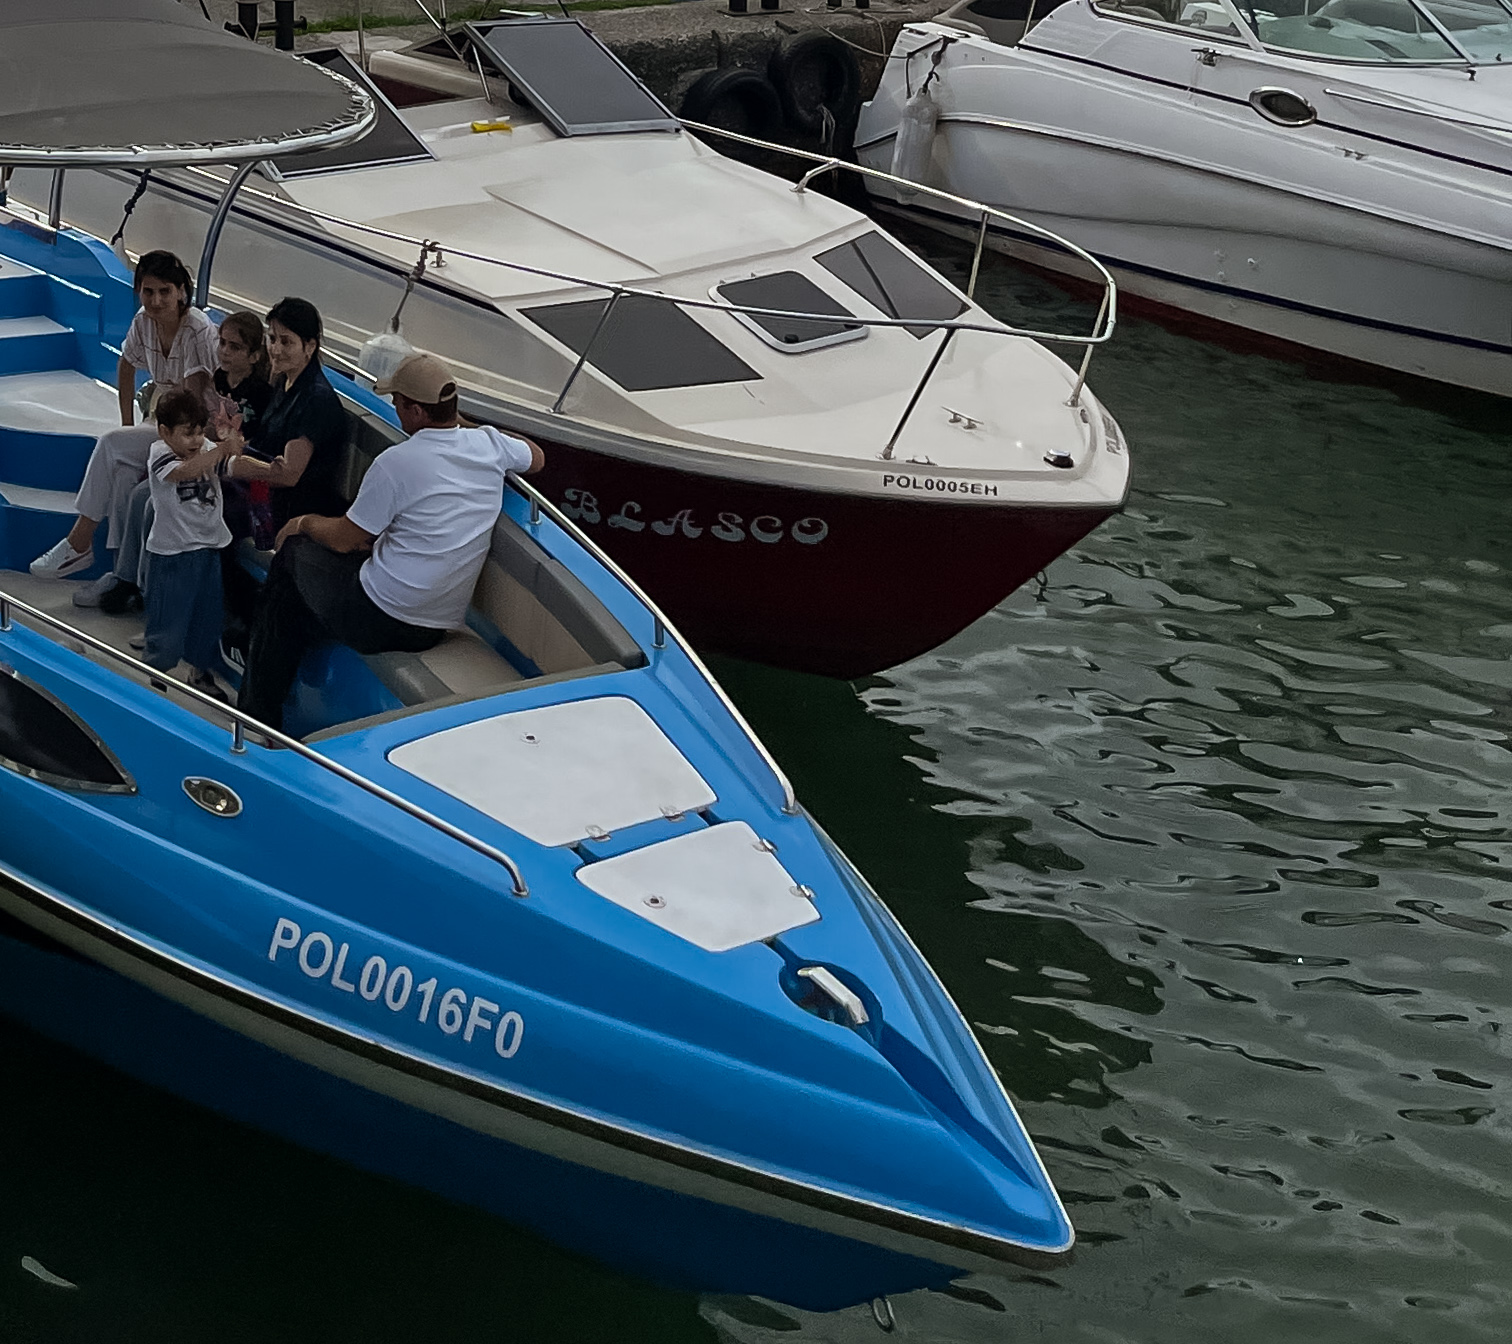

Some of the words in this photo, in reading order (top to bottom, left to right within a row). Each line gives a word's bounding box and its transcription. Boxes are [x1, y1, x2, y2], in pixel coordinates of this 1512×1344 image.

[882, 473, 999, 497] POL0005EH
[560, 487, 829, 545] BLASCO
[267, 917, 525, 1059] POL0016F0
